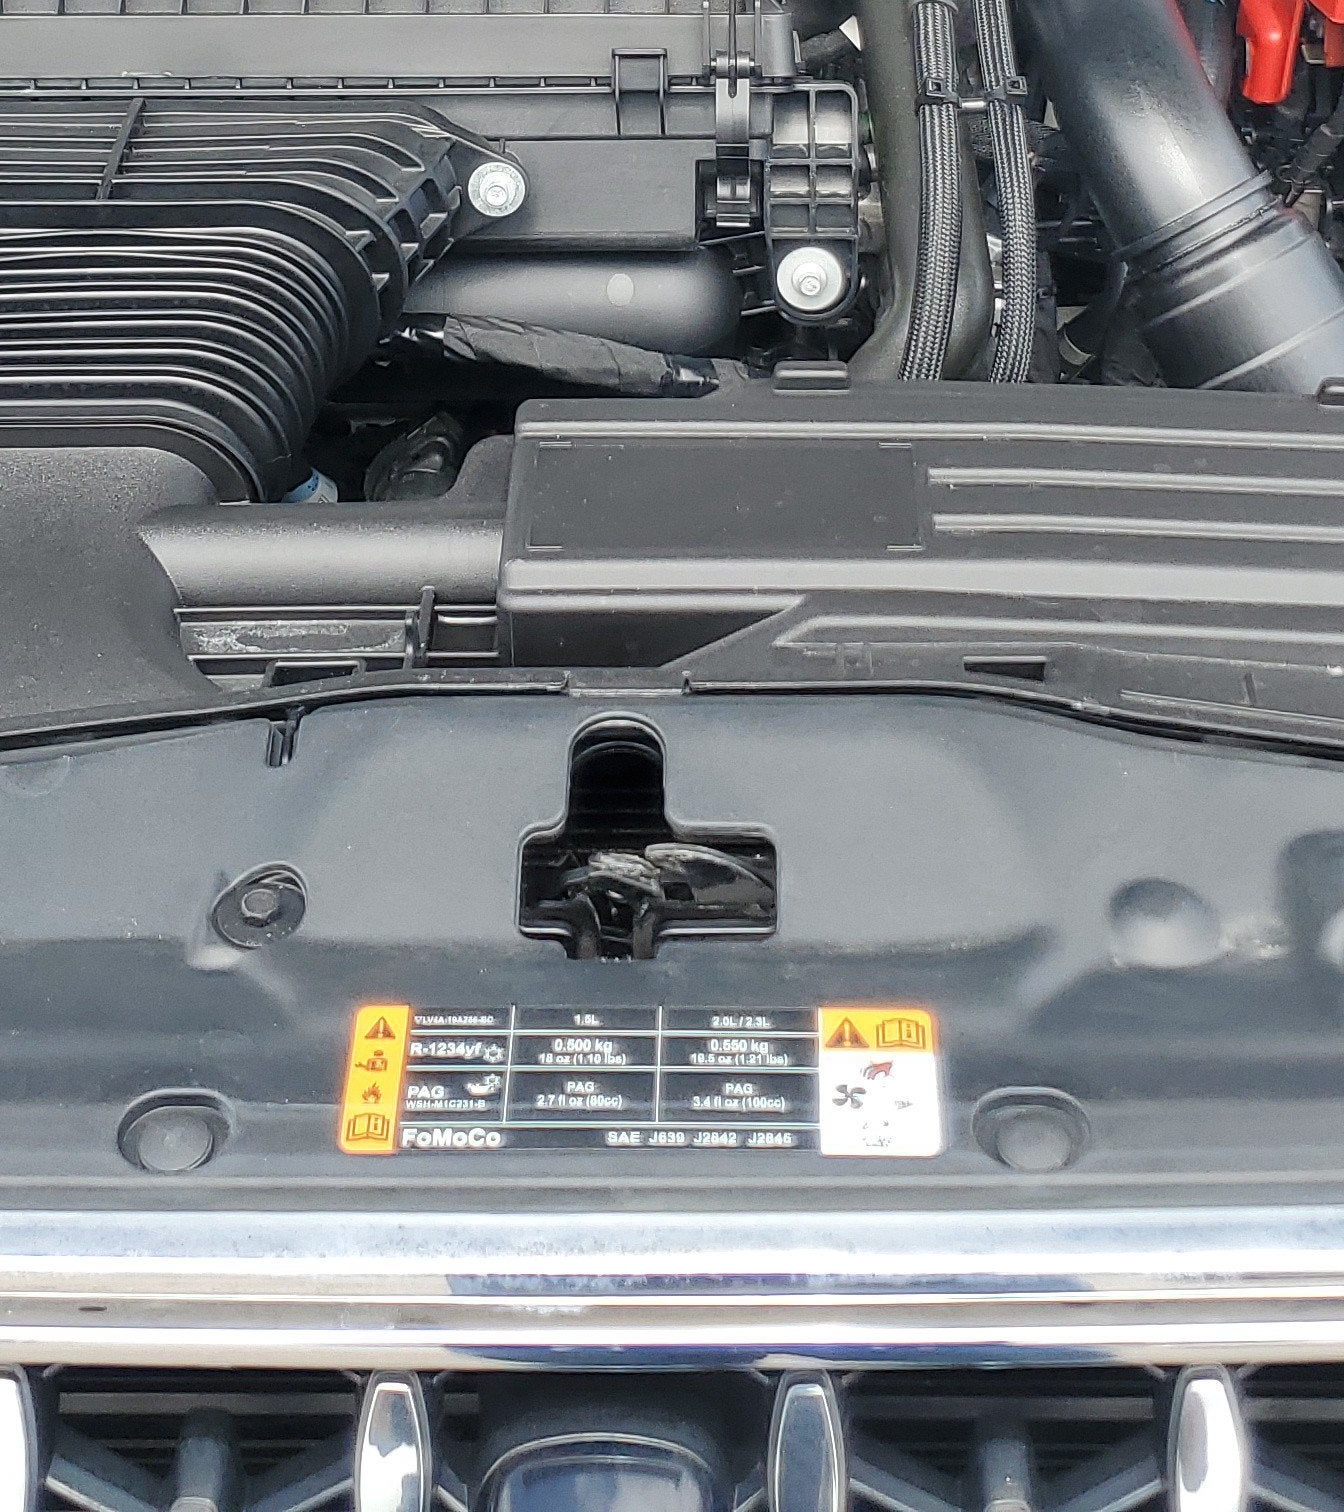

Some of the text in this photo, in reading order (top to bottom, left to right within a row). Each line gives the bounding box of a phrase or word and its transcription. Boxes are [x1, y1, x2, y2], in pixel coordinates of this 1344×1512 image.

[712, 1016, 737, 1028] 2.0L
[745, 1016, 770, 1028] 2.3L
[410, 1042, 483, 1059] R-1234yf
[554, 1038, 614, 1055] 0.500 kg
[710, 1039, 770, 1055] 0.550 kg
[555, 1056, 572, 1065] oz
[604, 1053, 627, 1066] lbs)
[717, 1056, 734, 1065] oz
[766, 1053, 789, 1066] lbs)
[407, 1085, 446, 1099] PAG
[566, 1080, 596, 1093] PAG
[725, 1082, 754, 1095] PAG
[536, 1094, 556, 1107] 2.7
[568, 1097, 584, 1107] oz
[692, 1095, 712, 1108] 3.4
[724, 1098, 740, 1108] oz
[741, 1095, 786, 1111] (100cc)
[401, 1127, 502, 1148] FoMoCo
[606, 1130, 642, 1144] SAE
[648, 1130, 686, 1144] J639
[692, 1131, 738, 1145] J2842
